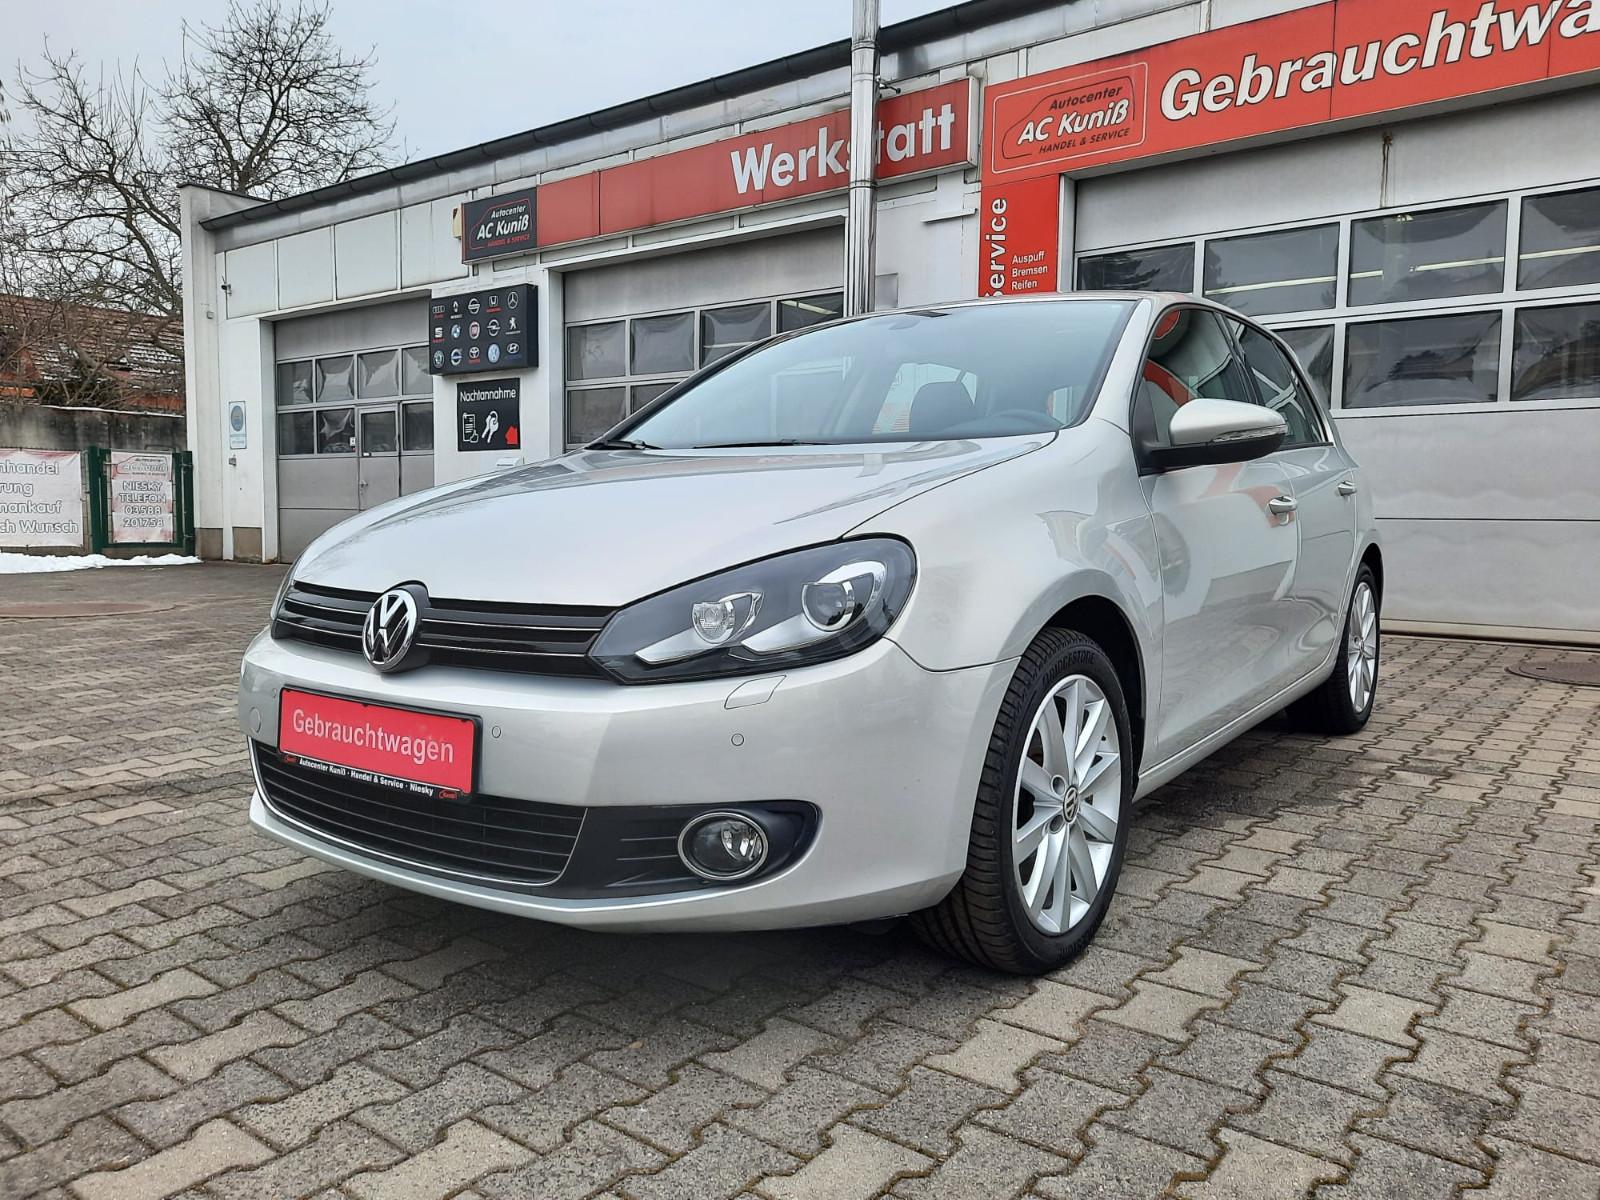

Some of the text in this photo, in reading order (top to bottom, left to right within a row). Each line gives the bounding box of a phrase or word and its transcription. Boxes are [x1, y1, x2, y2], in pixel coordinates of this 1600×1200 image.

[1049, 86, 1123, 111] Autocenter
[1017, 98, 1129, 145] AC Kuniß
[1039, 128, 1131, 154] HANDEL & SERVICE
[491, 205, 526, 219] Autocenter
[477, 214, 529, 240] AC Kuniß
[1012, 250, 1045, 264] Auspuff
[1012, 265, 1048, 277] Bremsen
[1011, 280, 1037, 290] Reifen
[460, 387, 516, 402] Nachtannahme
[122, 480, 163, 491] NIESKY
[119, 492, 167, 504] TELEFON
[124, 504, 162, 515] 03588
[19, 519, 79, 534] Wunsch
[123, 517, 164, 528] 201758
[292, 708, 454, 765] Gebrauchtwagen
[299, 758, 329, 772] Autocenter
[350, 770, 372, 782] Handel
[373, 775, 378, 783] &
[380, 776, 404, 789] Service
[410, 783, 434, 797] Niesky
